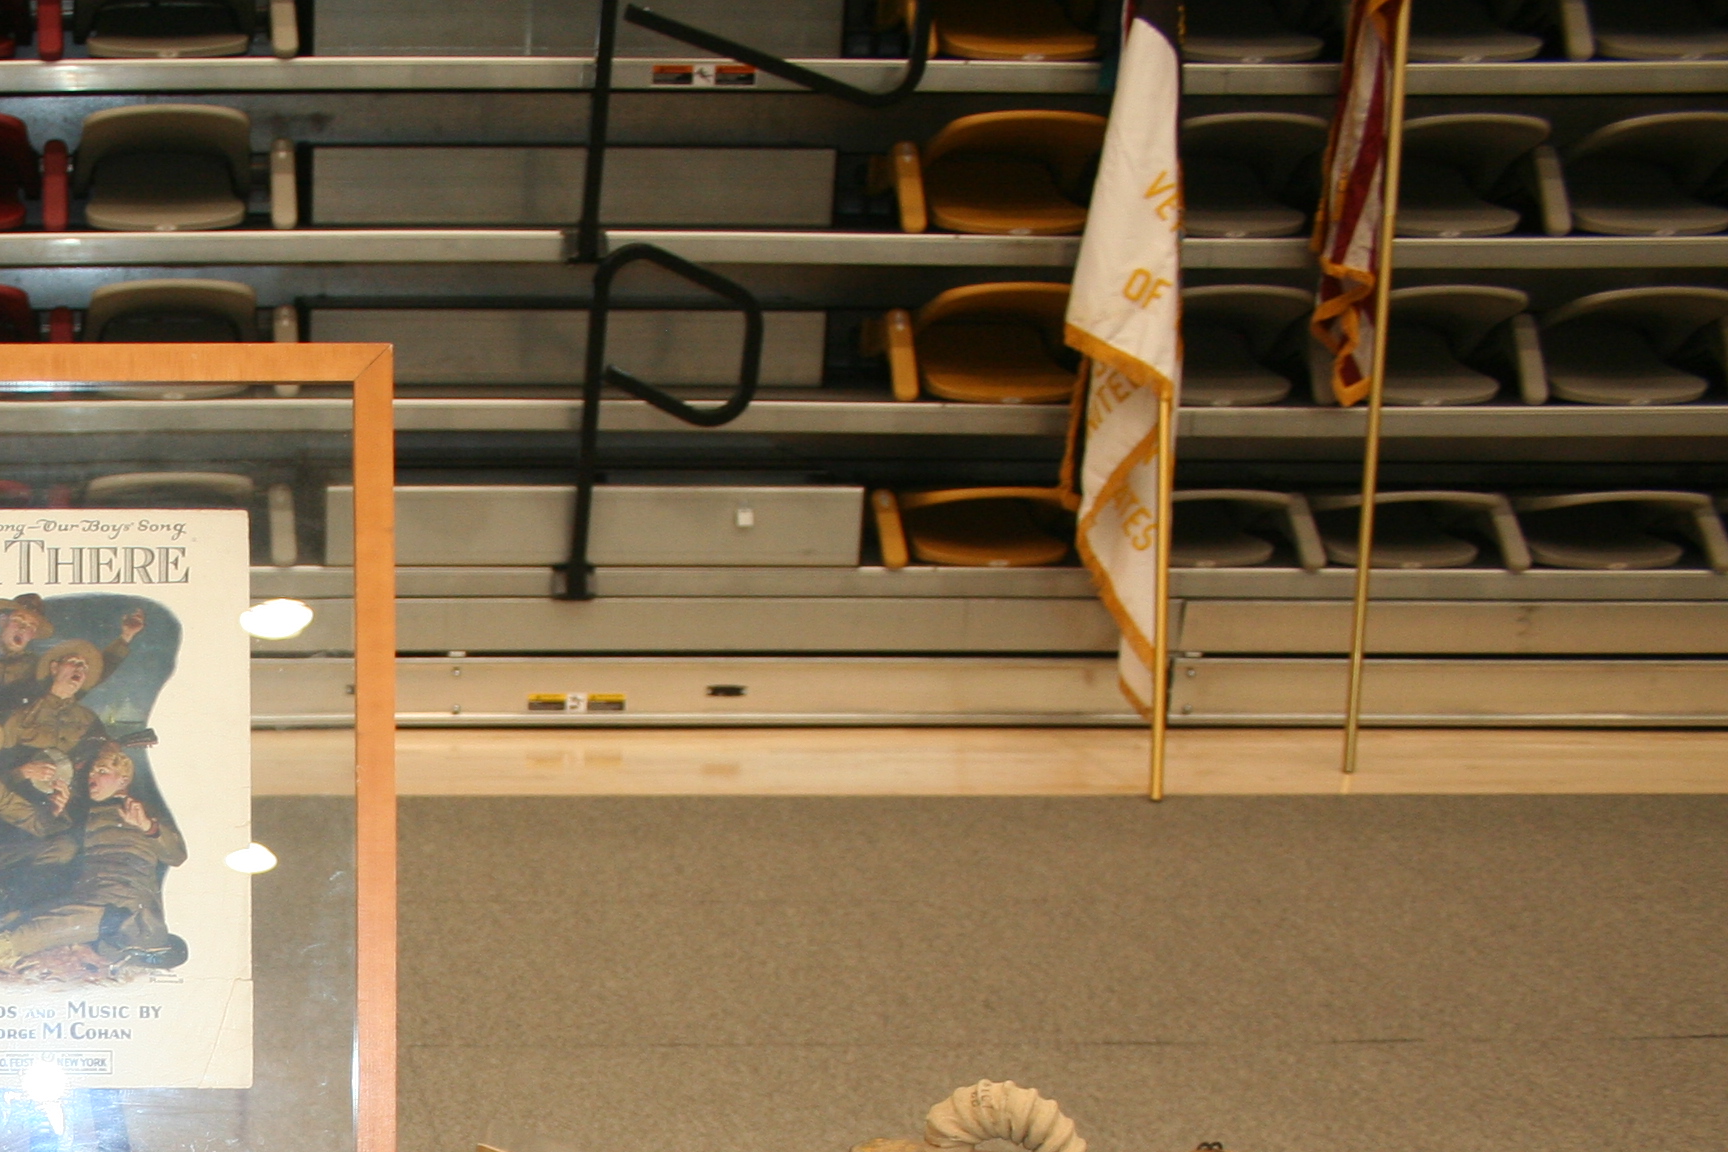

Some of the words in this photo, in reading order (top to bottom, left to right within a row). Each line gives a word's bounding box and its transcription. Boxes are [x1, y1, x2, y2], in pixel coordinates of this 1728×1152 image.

[1123, 268, 1173, 308] OF
[137, 518, 186, 541] Song
[4, 538, 190, 586] THERE
[24, 1006, 56, 1019] AND
[67, 1000, 130, 1019] MUSIC
[138, 1005, 162, 1019] BY
[42, 1022, 67, 1040] M.
[69, 1021, 132, 1040] COHAN
[9, 1057, 35, 1067] FEIST
[56, 1057, 79, 1067] NEW
[81, 1057, 108, 1067] YORK
